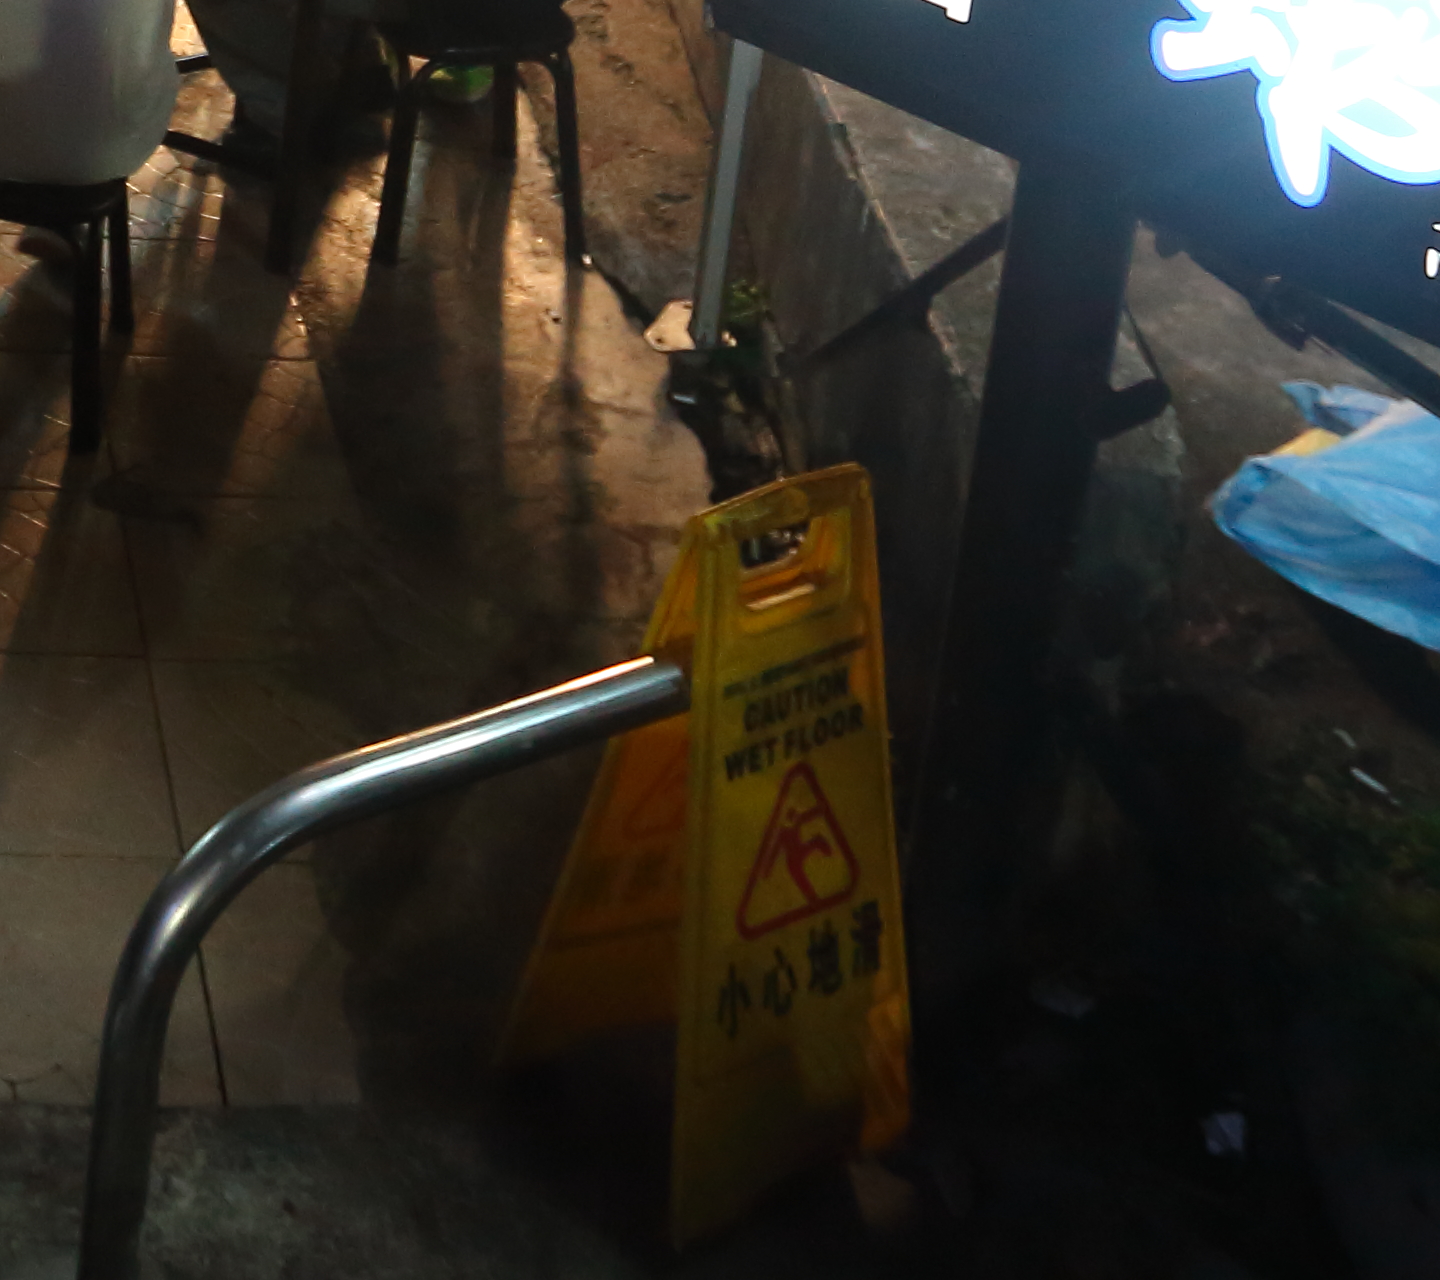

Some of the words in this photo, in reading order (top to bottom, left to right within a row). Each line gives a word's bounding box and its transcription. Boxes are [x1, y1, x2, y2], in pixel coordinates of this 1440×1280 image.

[744, 667, 849, 732] CAUTION
[725, 737, 777, 780] WET
[783, 702, 864, 760] FLOOR
[717, 898, 882, 1040] 小心地滑
